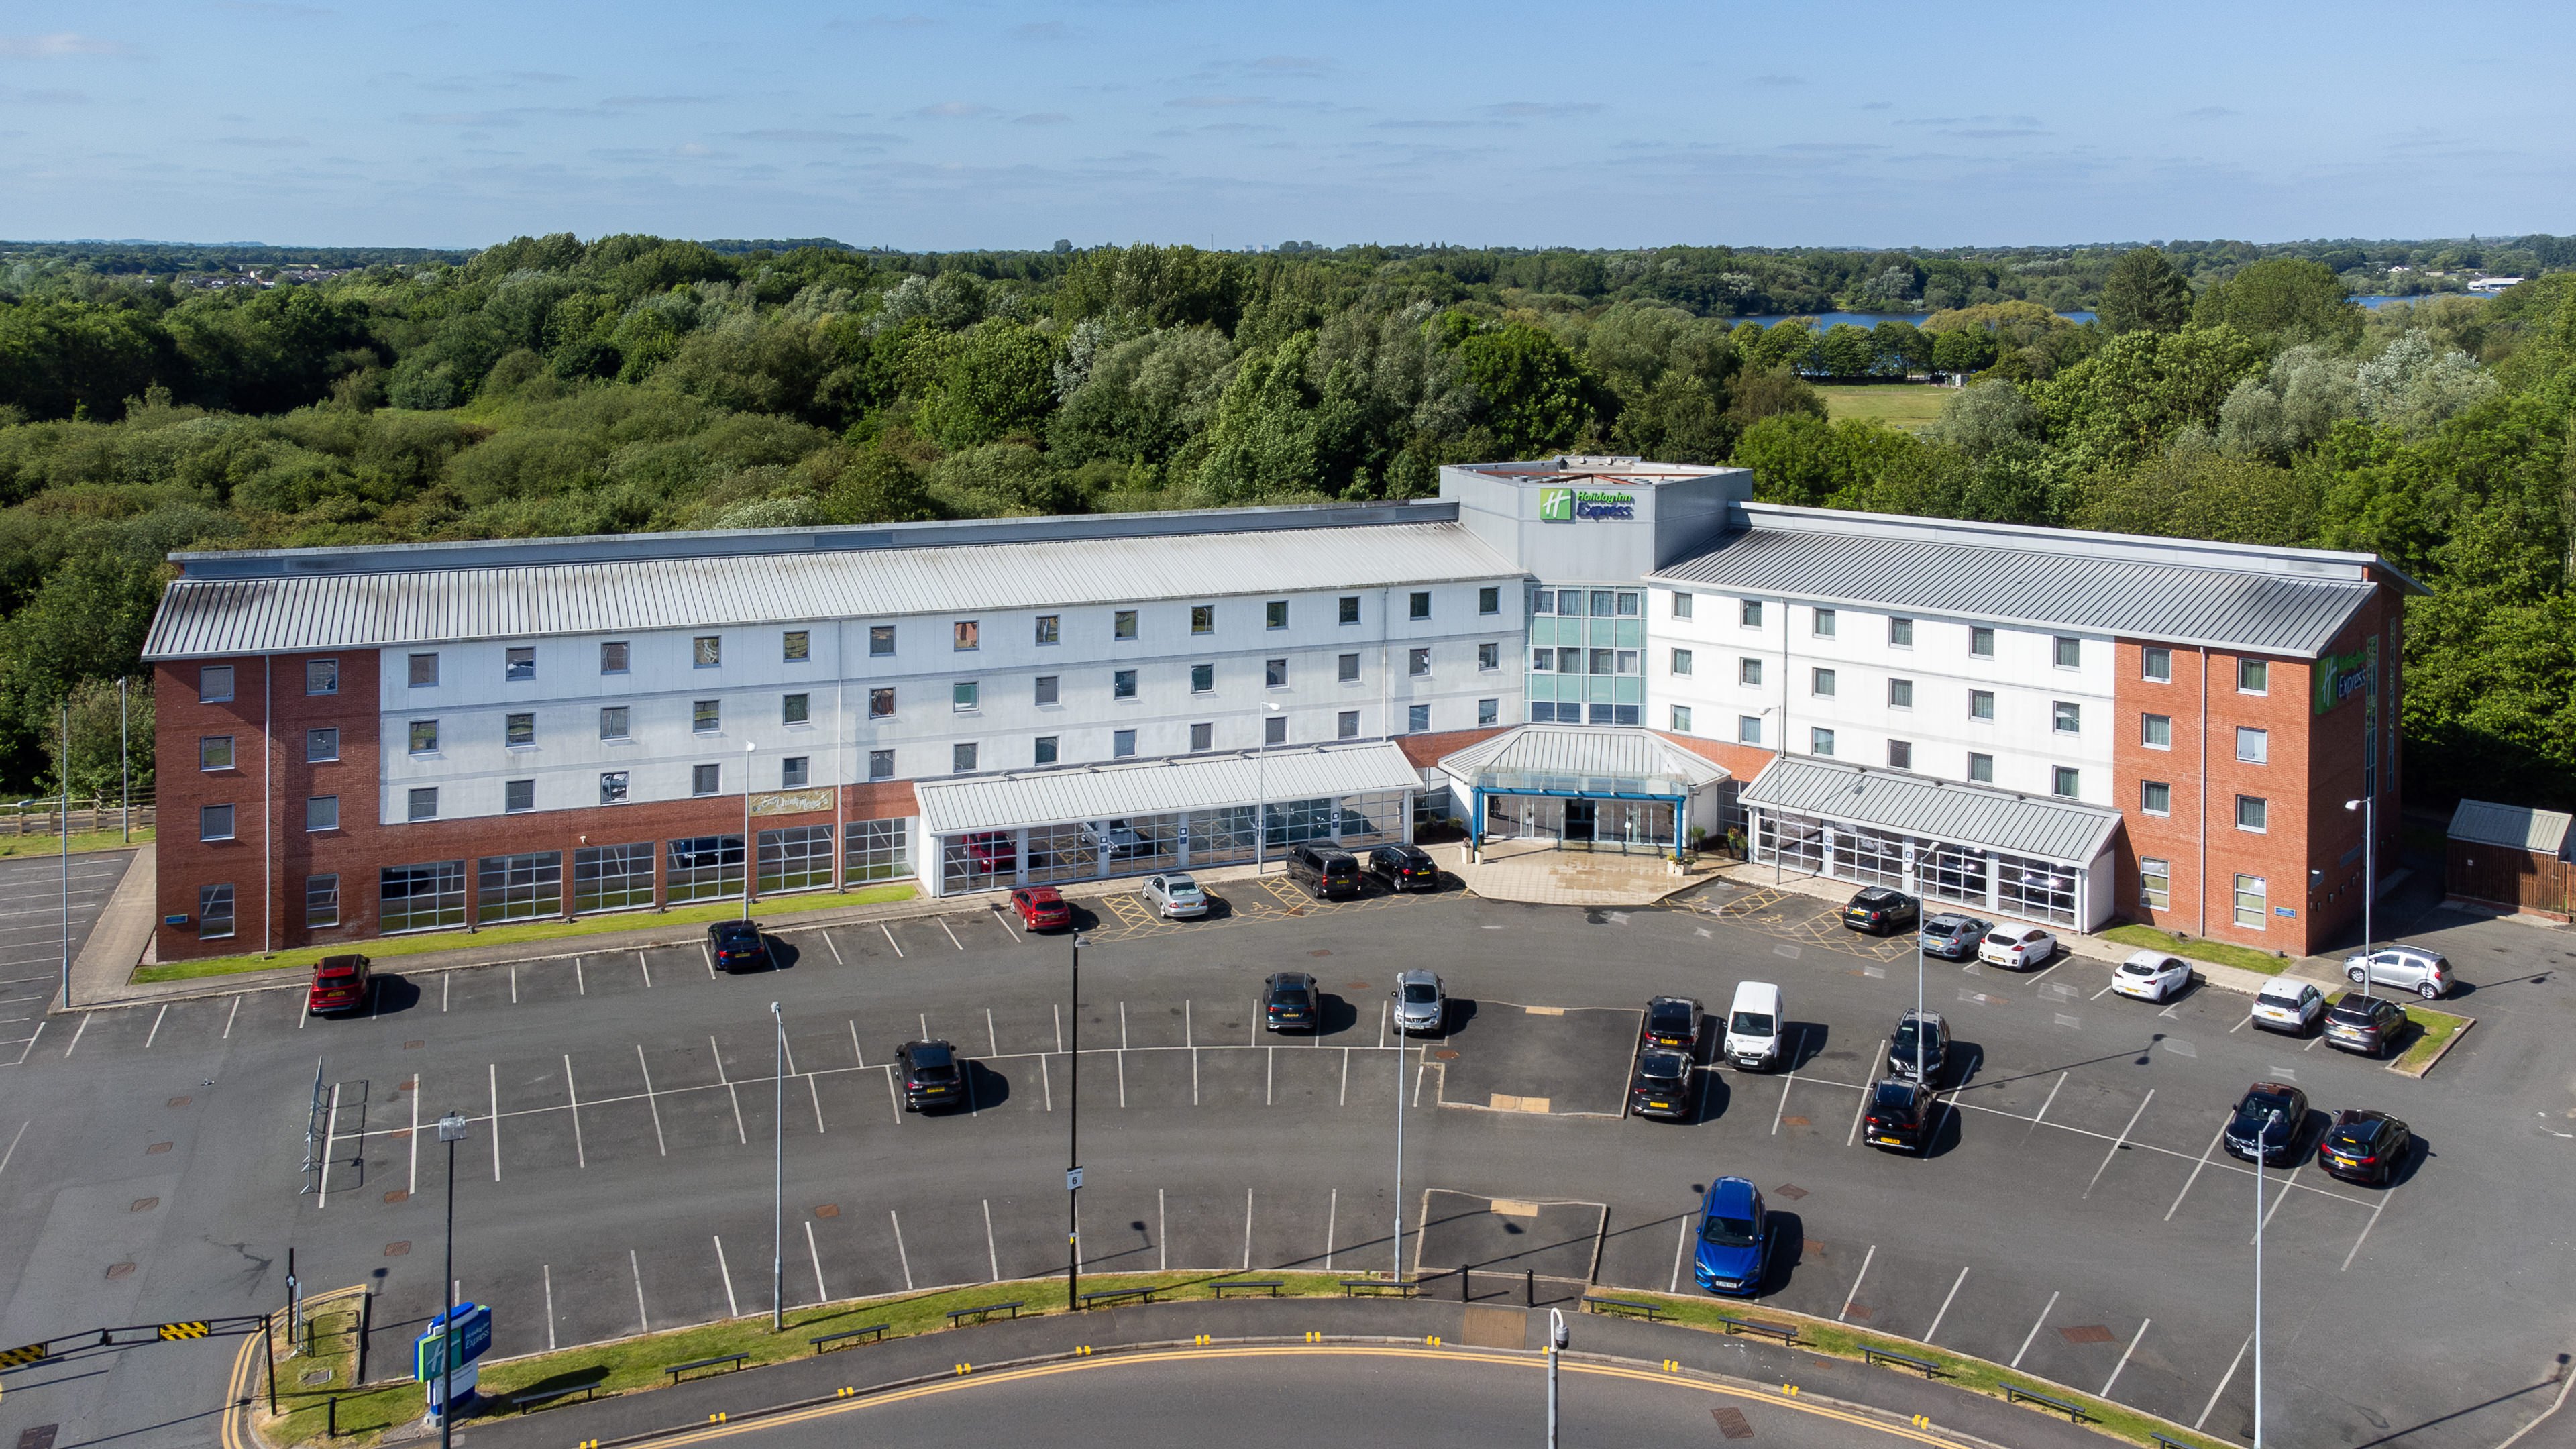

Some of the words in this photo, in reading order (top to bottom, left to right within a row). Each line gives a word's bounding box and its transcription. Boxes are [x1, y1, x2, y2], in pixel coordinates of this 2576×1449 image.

[1577, 491, 1615, 503] Holiday
[1615, 492, 1632, 502] Inn
[1577, 502, 1635, 521] Express
[2339, 665, 2365, 700] Express
[1072, 1176, 1077, 1185] 6
[465, 1328, 490, 1350] Express
